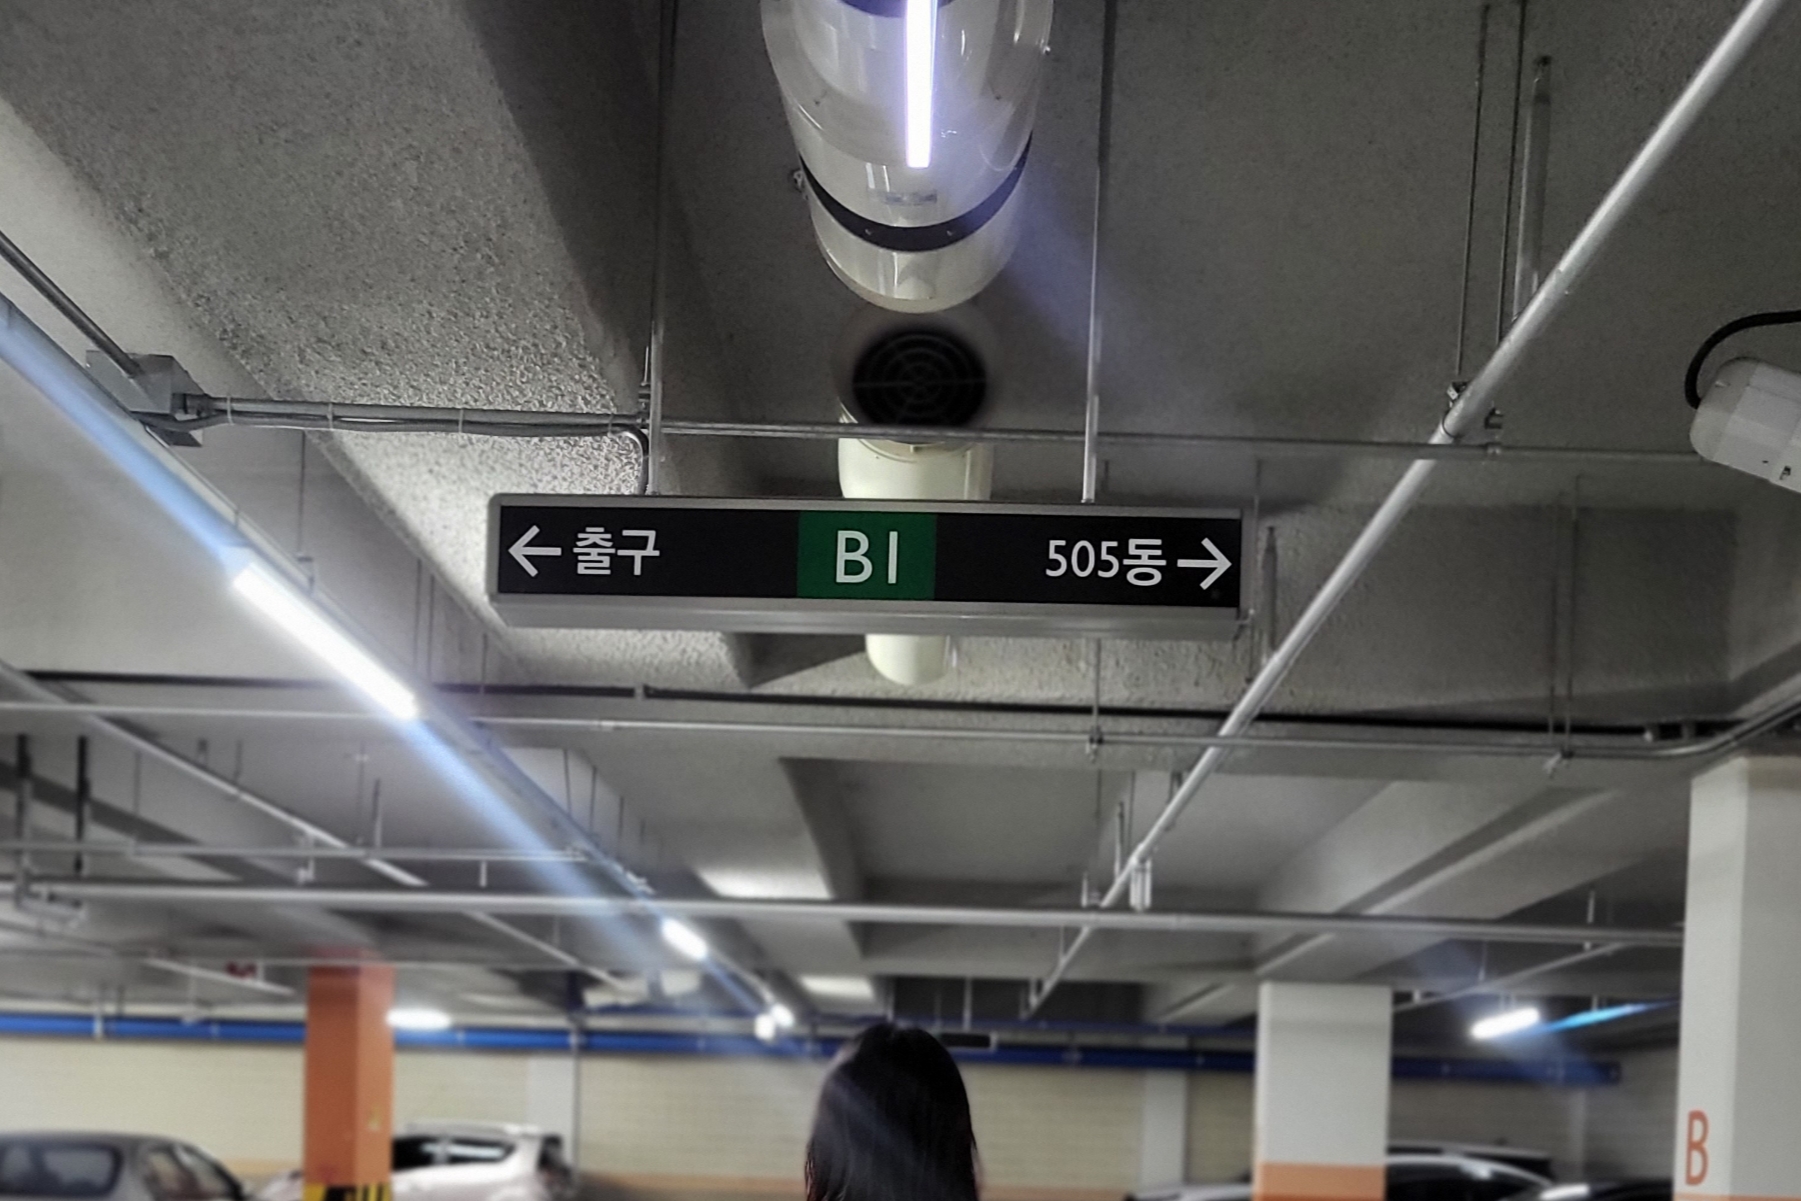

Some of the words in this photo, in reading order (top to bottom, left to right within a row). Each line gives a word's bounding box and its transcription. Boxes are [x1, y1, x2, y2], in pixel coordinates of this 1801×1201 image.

[573, 527, 660, 576] 출구
[1045, 538, 1167, 586] 505동
[1685, 1109, 1710, 1186] B
